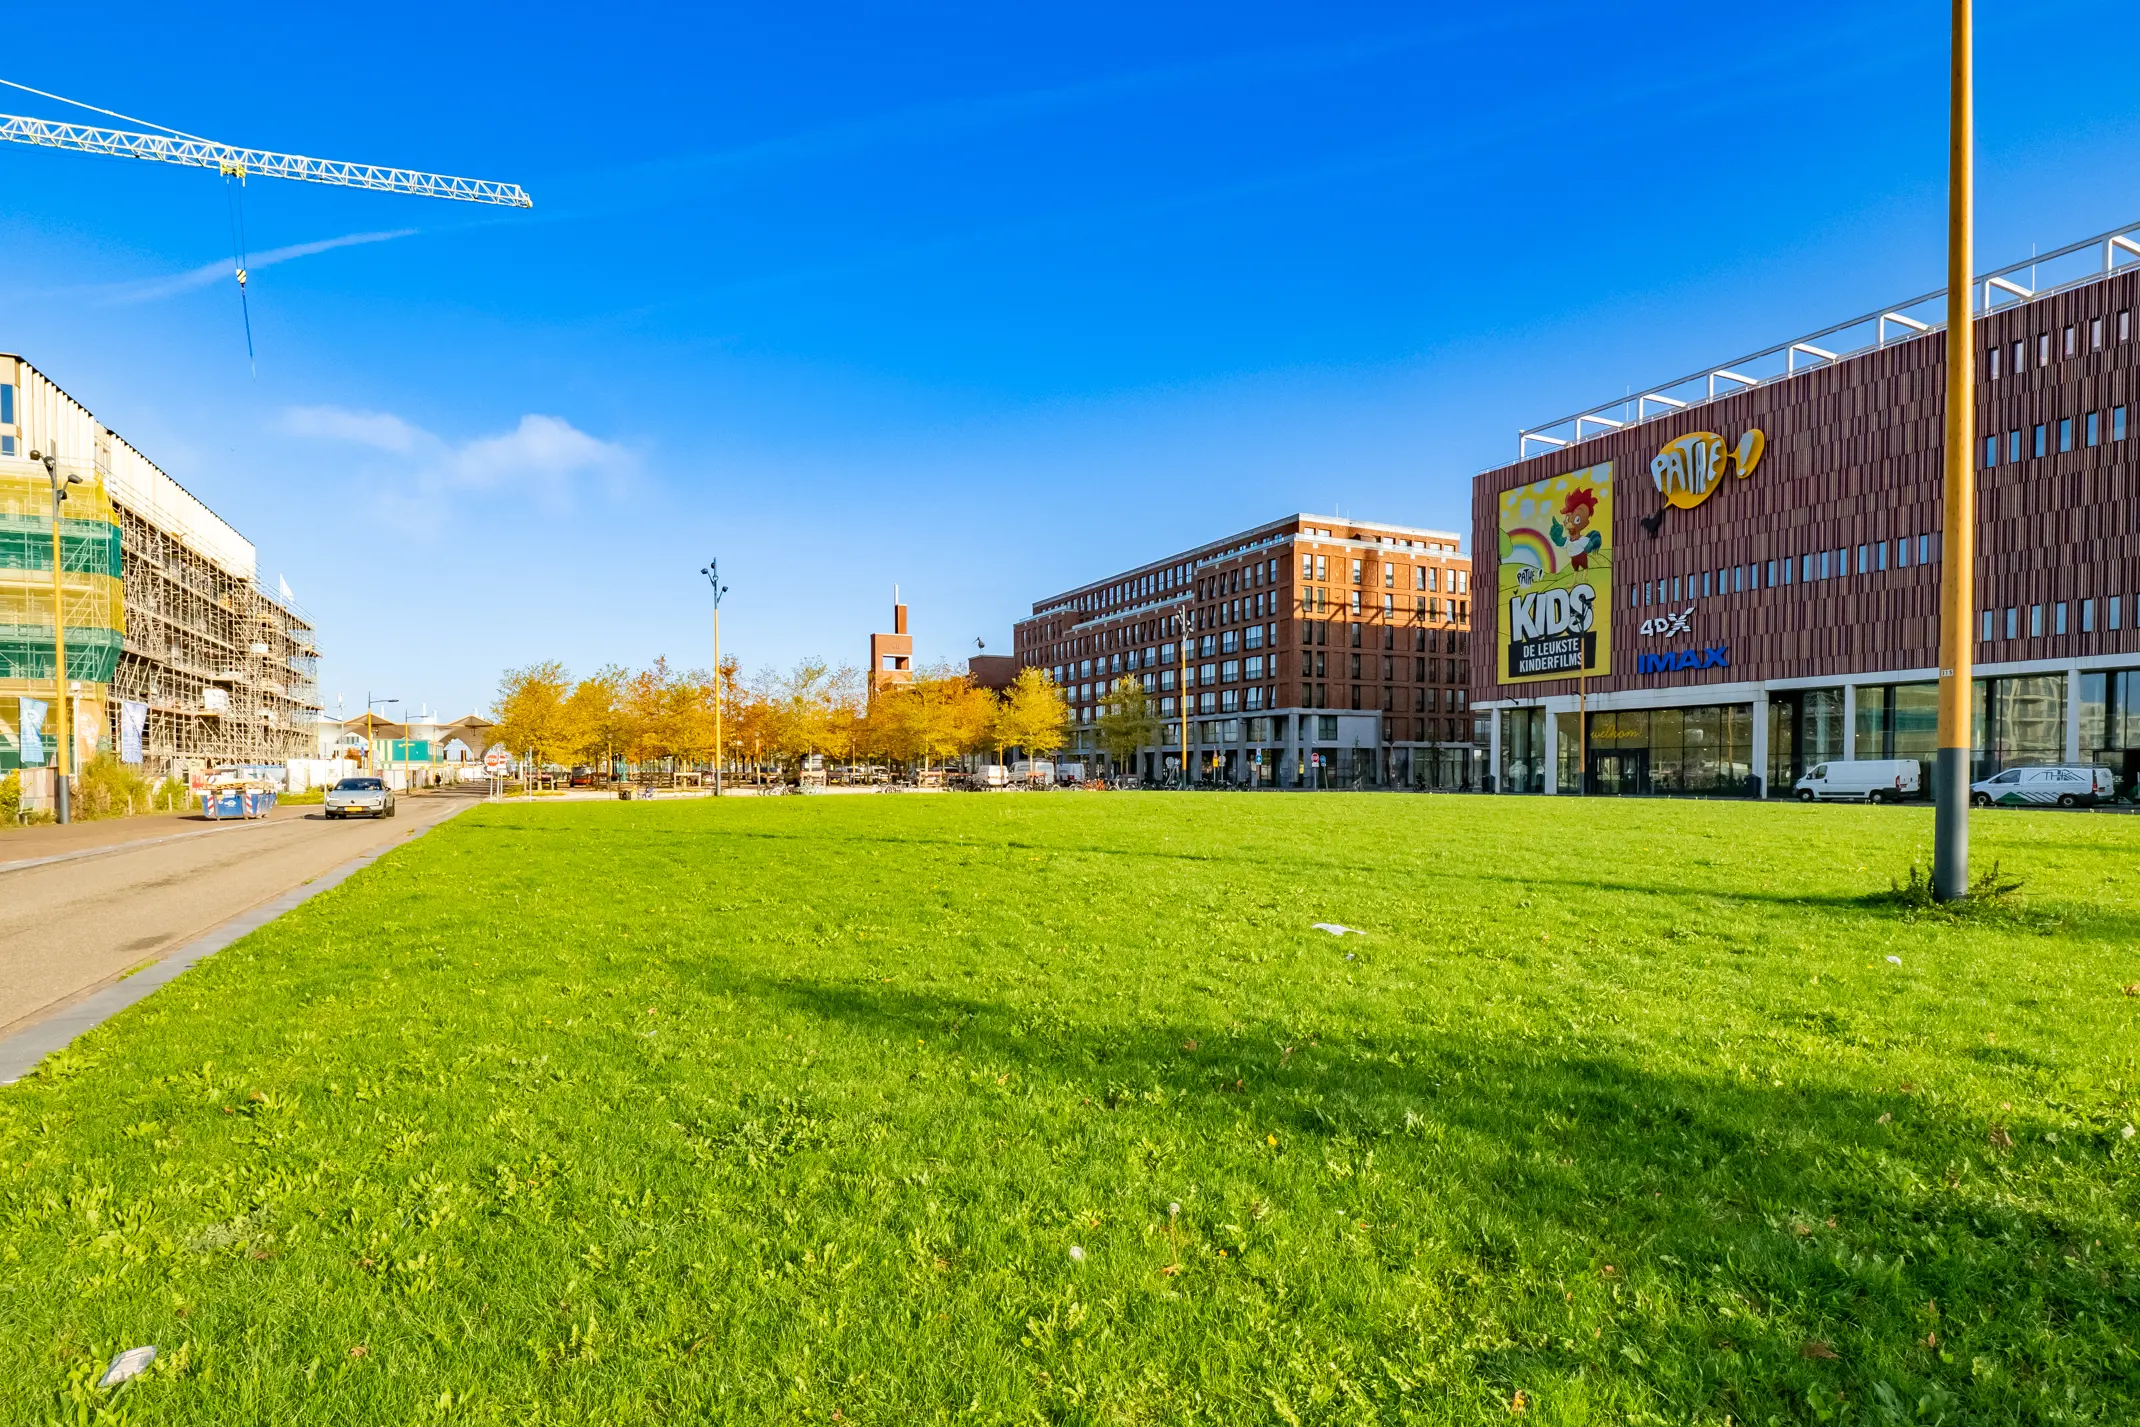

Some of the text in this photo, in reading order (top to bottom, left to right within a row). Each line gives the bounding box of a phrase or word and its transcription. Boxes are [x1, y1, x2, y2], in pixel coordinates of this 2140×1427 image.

[1510, 584, 1596, 642] KIDS
[1640, 607, 1696, 638] 4DX
[1519, 651, 1582, 673] KINDERFILMS
[1523, 637, 1580, 658] DE LEUKSTE
[1637, 645, 1729, 674] IMAX
